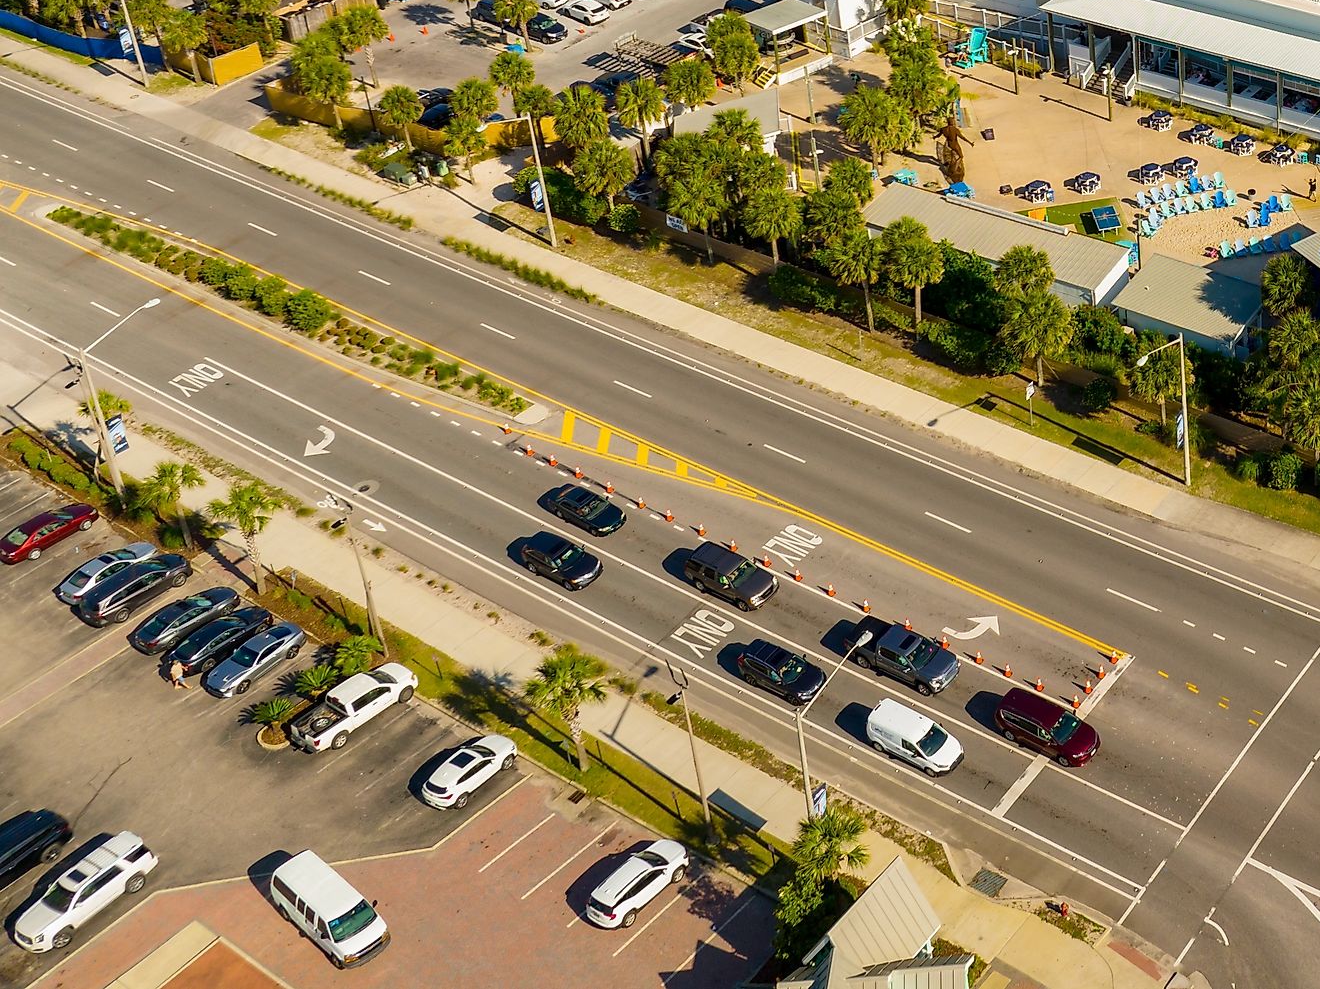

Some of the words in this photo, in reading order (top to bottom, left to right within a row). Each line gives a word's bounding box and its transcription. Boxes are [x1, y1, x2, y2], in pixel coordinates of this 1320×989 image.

[168, 363, 224, 398] ONLY
[762, 524, 823, 567] ONLY
[670, 609, 735, 659] ONLY
